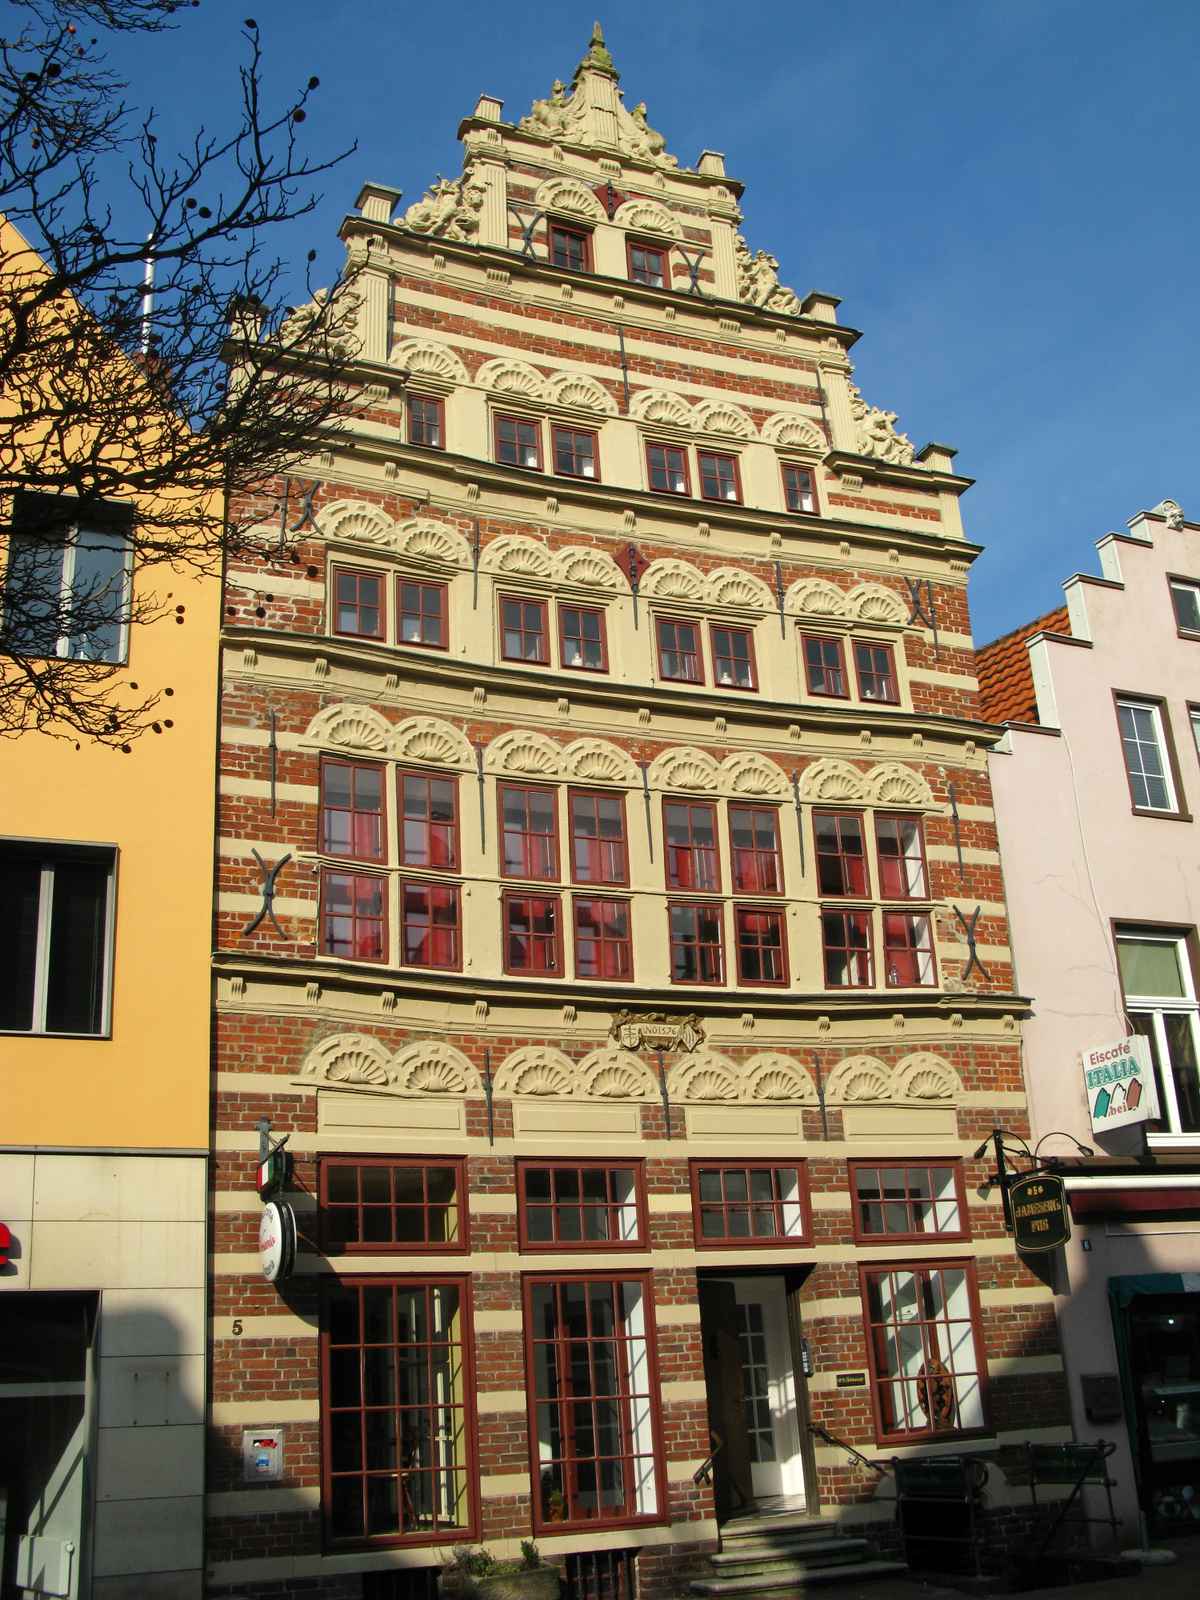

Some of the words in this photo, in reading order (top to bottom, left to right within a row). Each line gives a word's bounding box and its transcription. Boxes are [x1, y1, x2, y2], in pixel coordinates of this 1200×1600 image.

[1090, 1040, 1131, 1065] Eiscafé
[1087, 1054, 1140, 1089] ITALIA
[232, 1319, 243, 1336] 5
